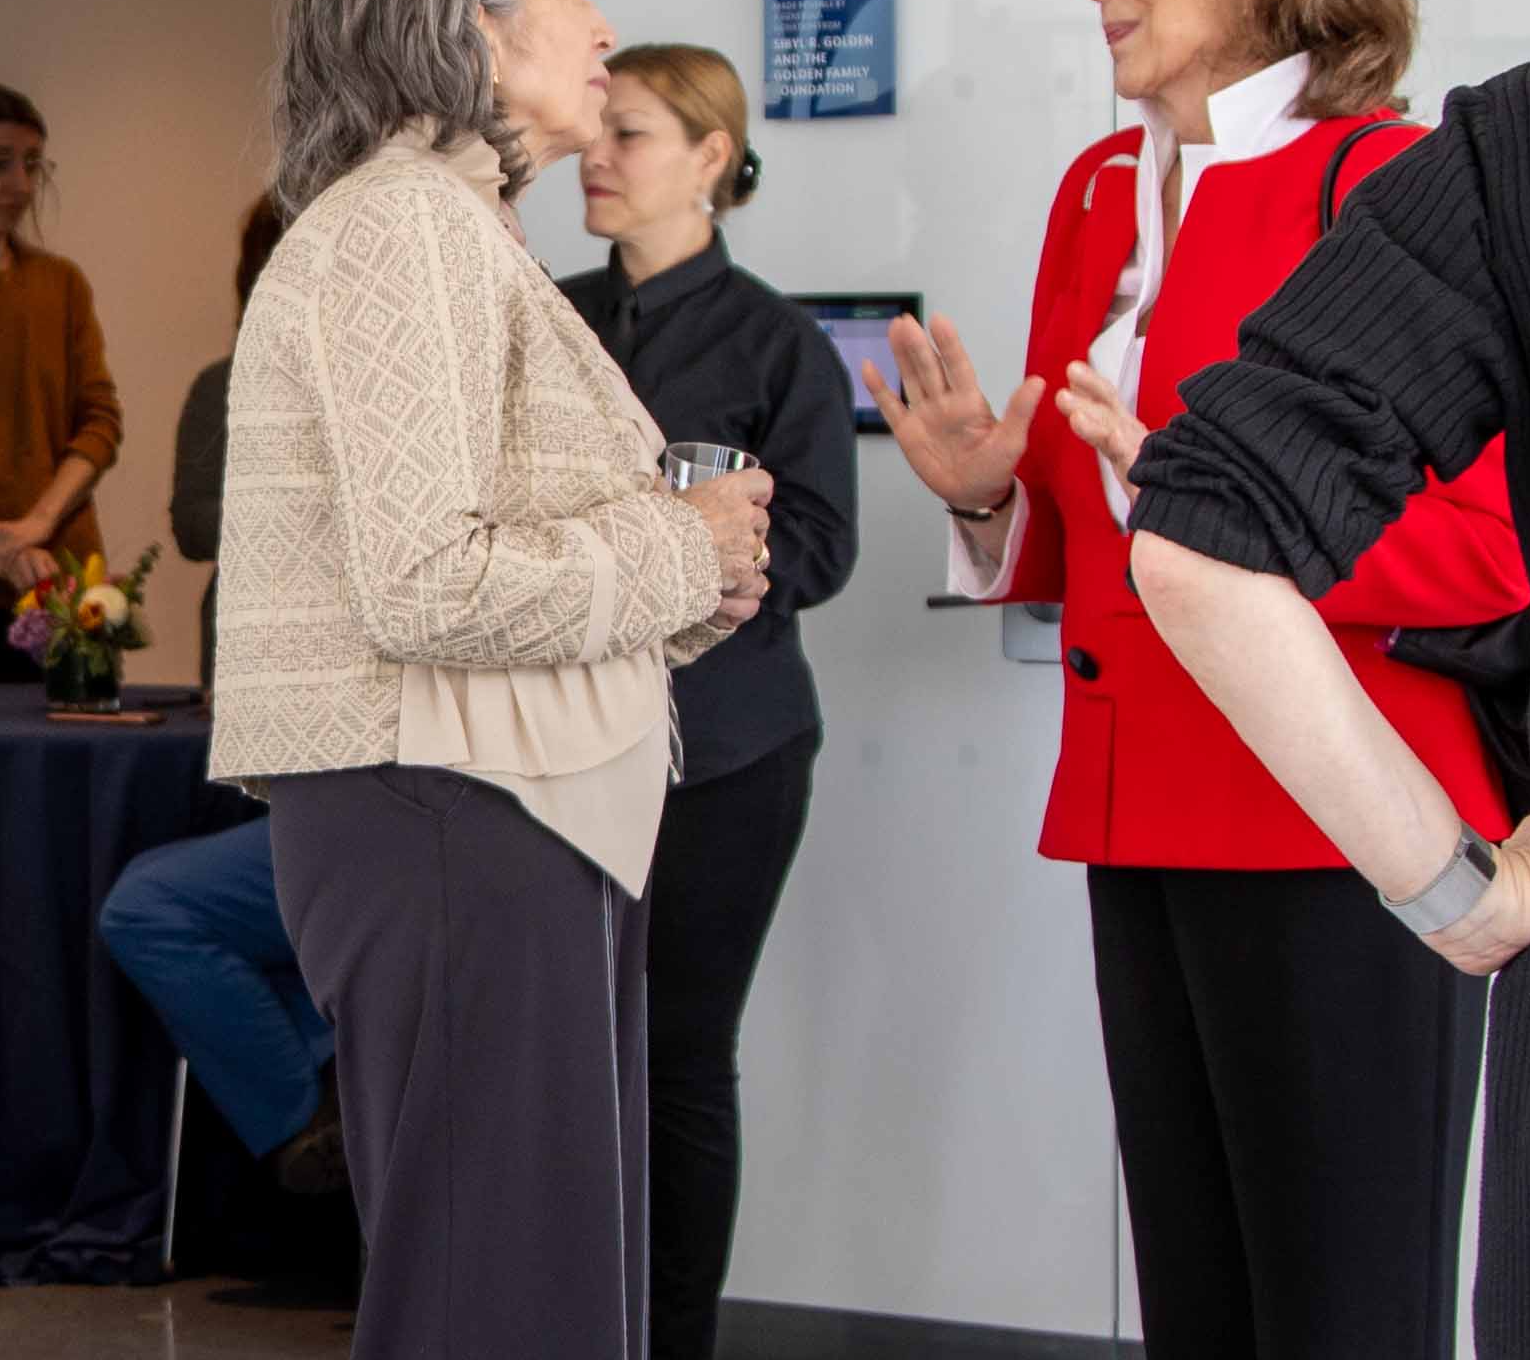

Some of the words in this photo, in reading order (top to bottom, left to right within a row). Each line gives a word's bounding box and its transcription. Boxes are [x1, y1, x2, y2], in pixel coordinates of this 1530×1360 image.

[823, 34, 874, 48] GOLDEN
[774, 53, 800, 65] AND
[804, 52, 827, 64] THE
[774, 67, 823, 81] GOLDEN
[826, 65, 870, 79] FAMILY
[779, 81, 855, 95] OUNDATION
